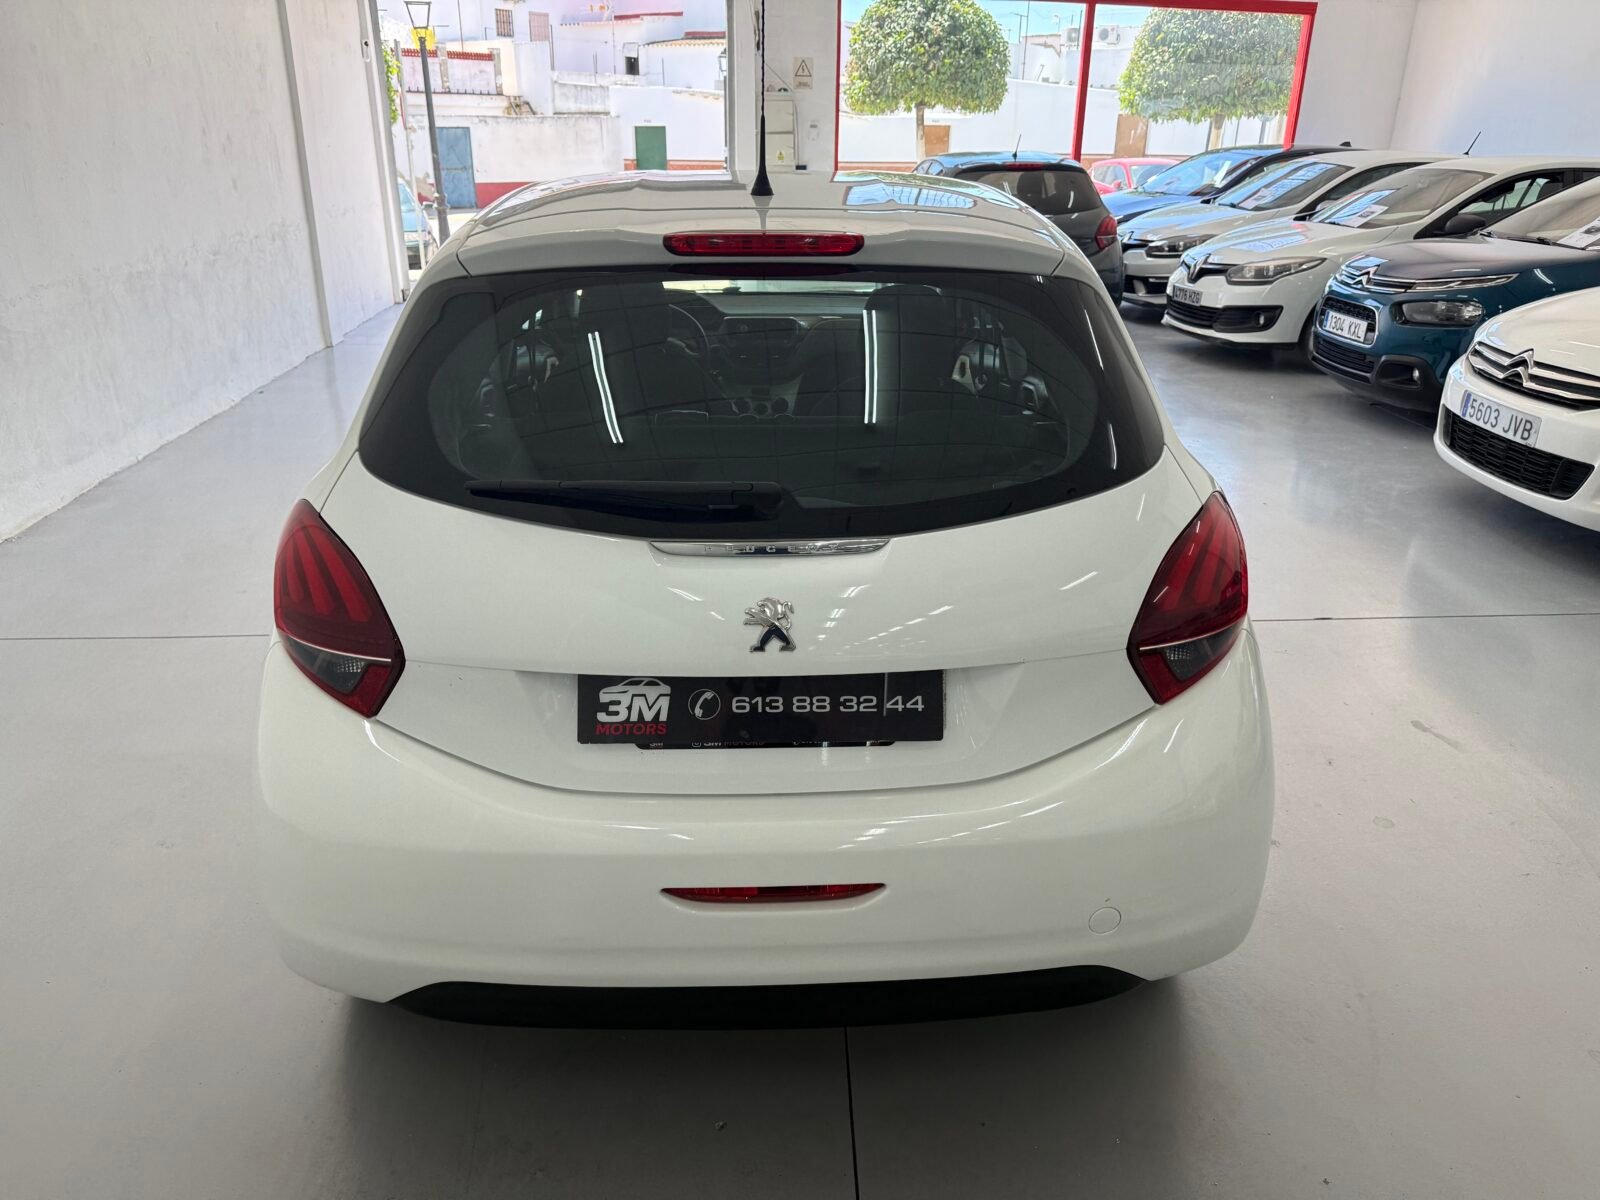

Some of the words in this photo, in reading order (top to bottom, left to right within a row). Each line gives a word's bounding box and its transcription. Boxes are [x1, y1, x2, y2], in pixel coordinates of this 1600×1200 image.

[1328, 315, 1345, 333] 1304
[1347, 320, 1361, 339] KXL
[1469, 397, 1500, 428] 5603
[1502, 413, 1533, 441] JVB
[597, 691, 670, 723] 3M
[731, 696, 783, 713] 613
[792, 695, 831, 713] 88
[839, 695, 877, 712] 32
[886, 695, 925, 712] 44
[595, 723, 668, 736] MOTORS
